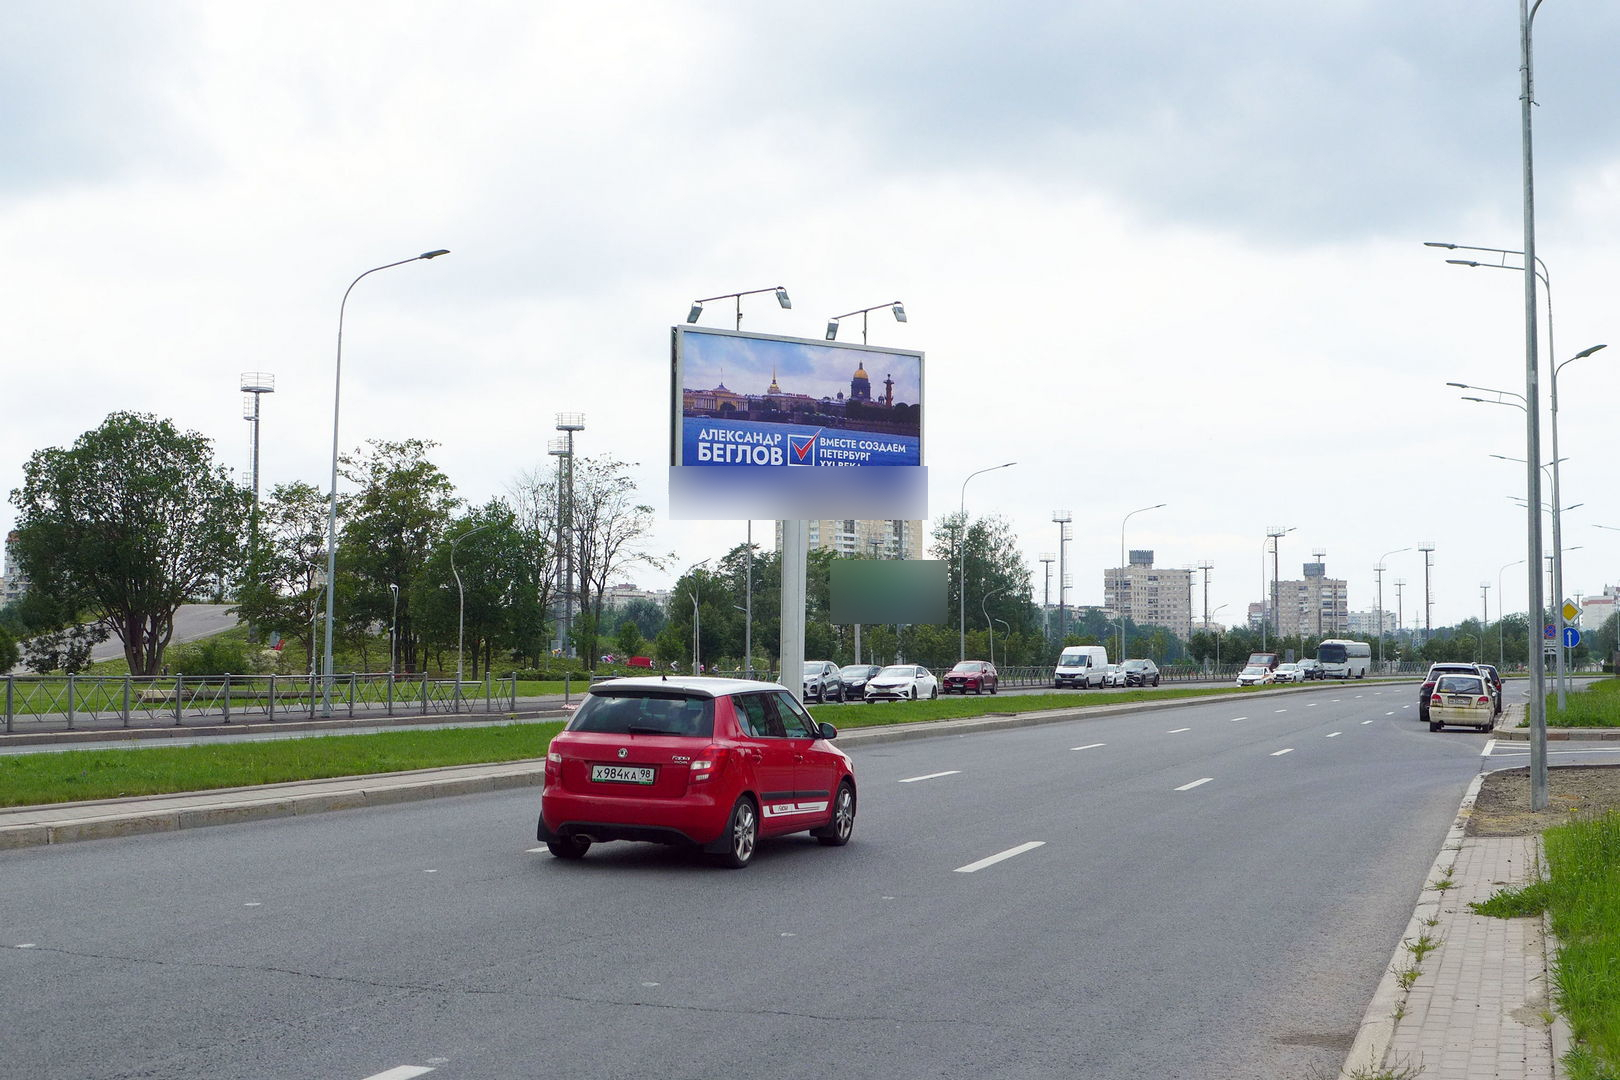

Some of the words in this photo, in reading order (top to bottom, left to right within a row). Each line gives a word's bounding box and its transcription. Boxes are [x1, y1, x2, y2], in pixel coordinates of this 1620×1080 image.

[698, 428, 782, 446] АЛЕКСАНДР
[819, 437, 857, 448] ВМЕСТЕ
[859, 440, 906, 453] СОЗДАЕМ
[698, 442, 783, 466] БЕГЛОВ
[819, 449, 871, 461] ПЕТЕРБУРГ
[640, 769, 651, 778] 98
